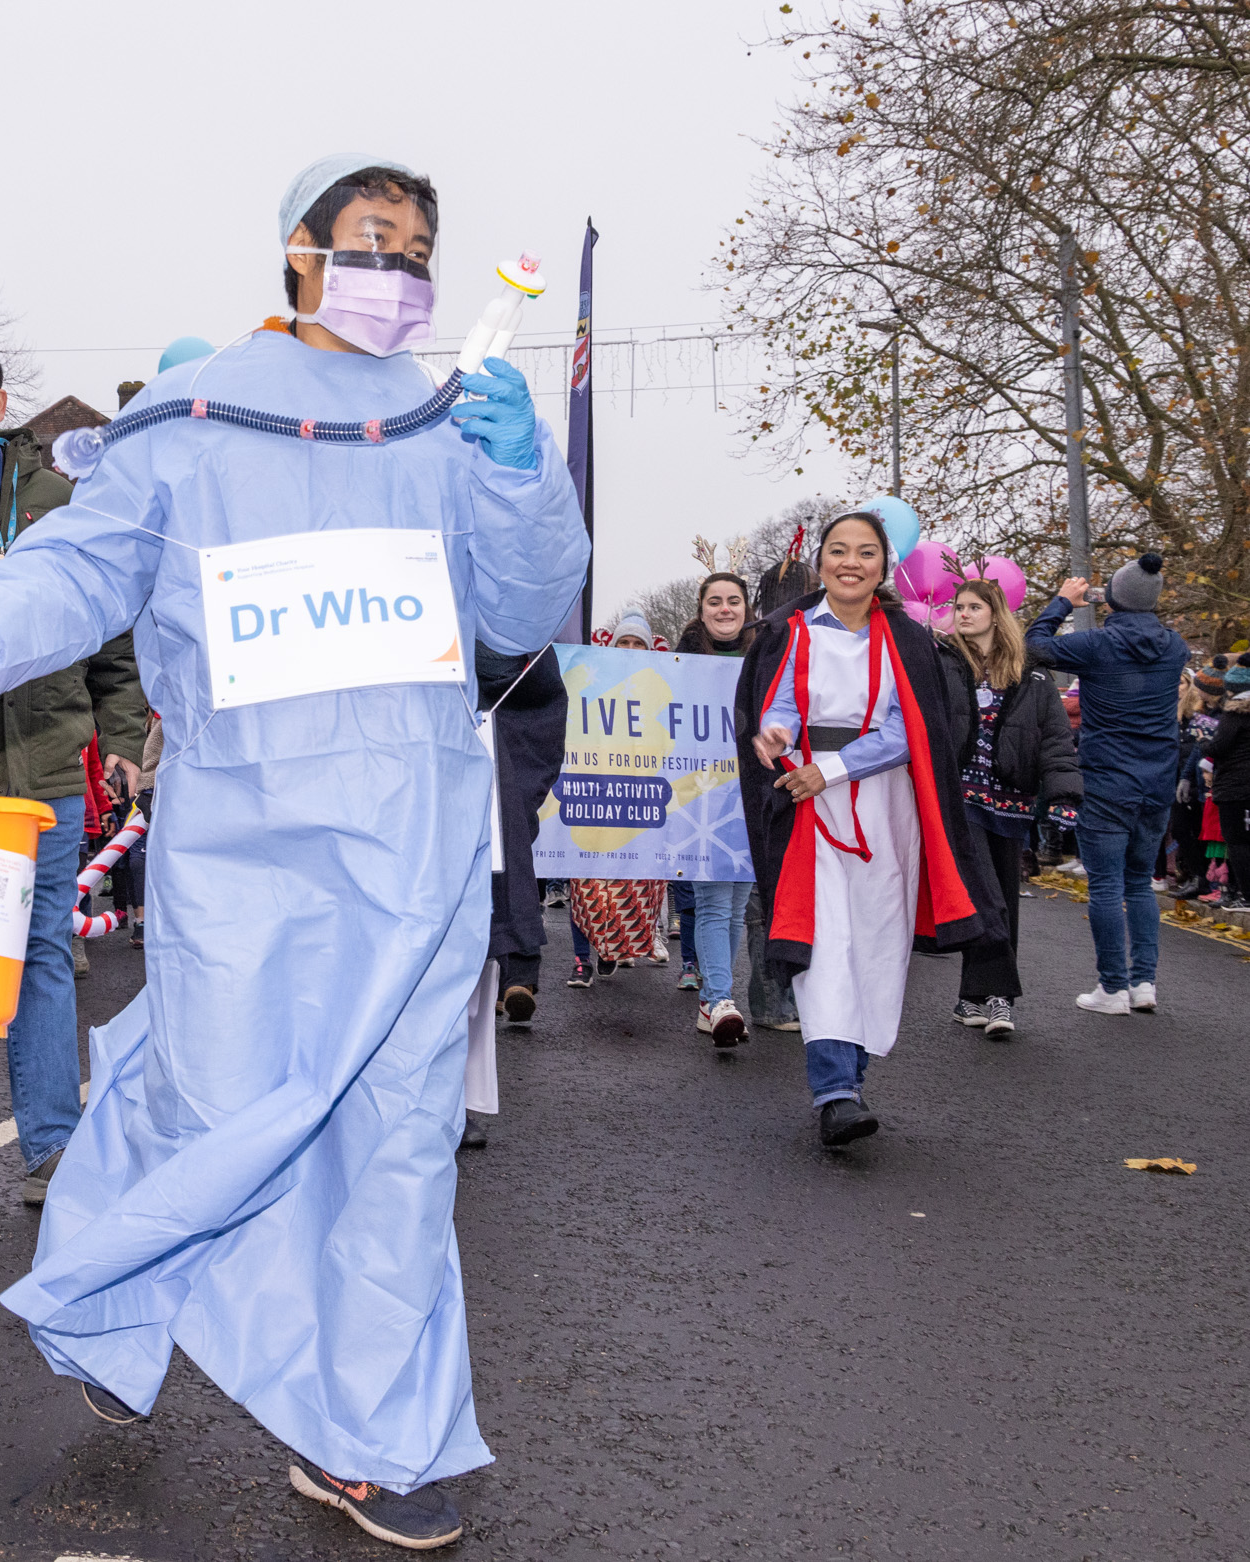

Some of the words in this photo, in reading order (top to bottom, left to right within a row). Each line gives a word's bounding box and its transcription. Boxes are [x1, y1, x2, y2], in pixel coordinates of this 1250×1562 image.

[230, 603, 288, 643] Dr
[303, 587, 424, 629] Who
[581, 696, 643, 738] IVE
[669, 702, 737, 743] FUN
[565, 751, 578, 765] IN
[584, 752, 598, 766] US
[609, 753, 630, 767] FOR
[635, 754, 657, 768] OUR
[662, 756, 707, 771] FESTIVE
[713, 759, 735, 773] FUN
[563, 780, 600, 797] MULTI
[606, 782, 664, 799] ACTIVITY
[566, 803, 622, 821] HOLIDAY
[627, 805, 661, 821] CLUB
[535, 850, 546, 858] FRI
[548, 850, 556, 858] 22
[579, 851, 591, 859] WED
[592, 851, 599, 859] 27
[628, 852, 639, 860] DEC
